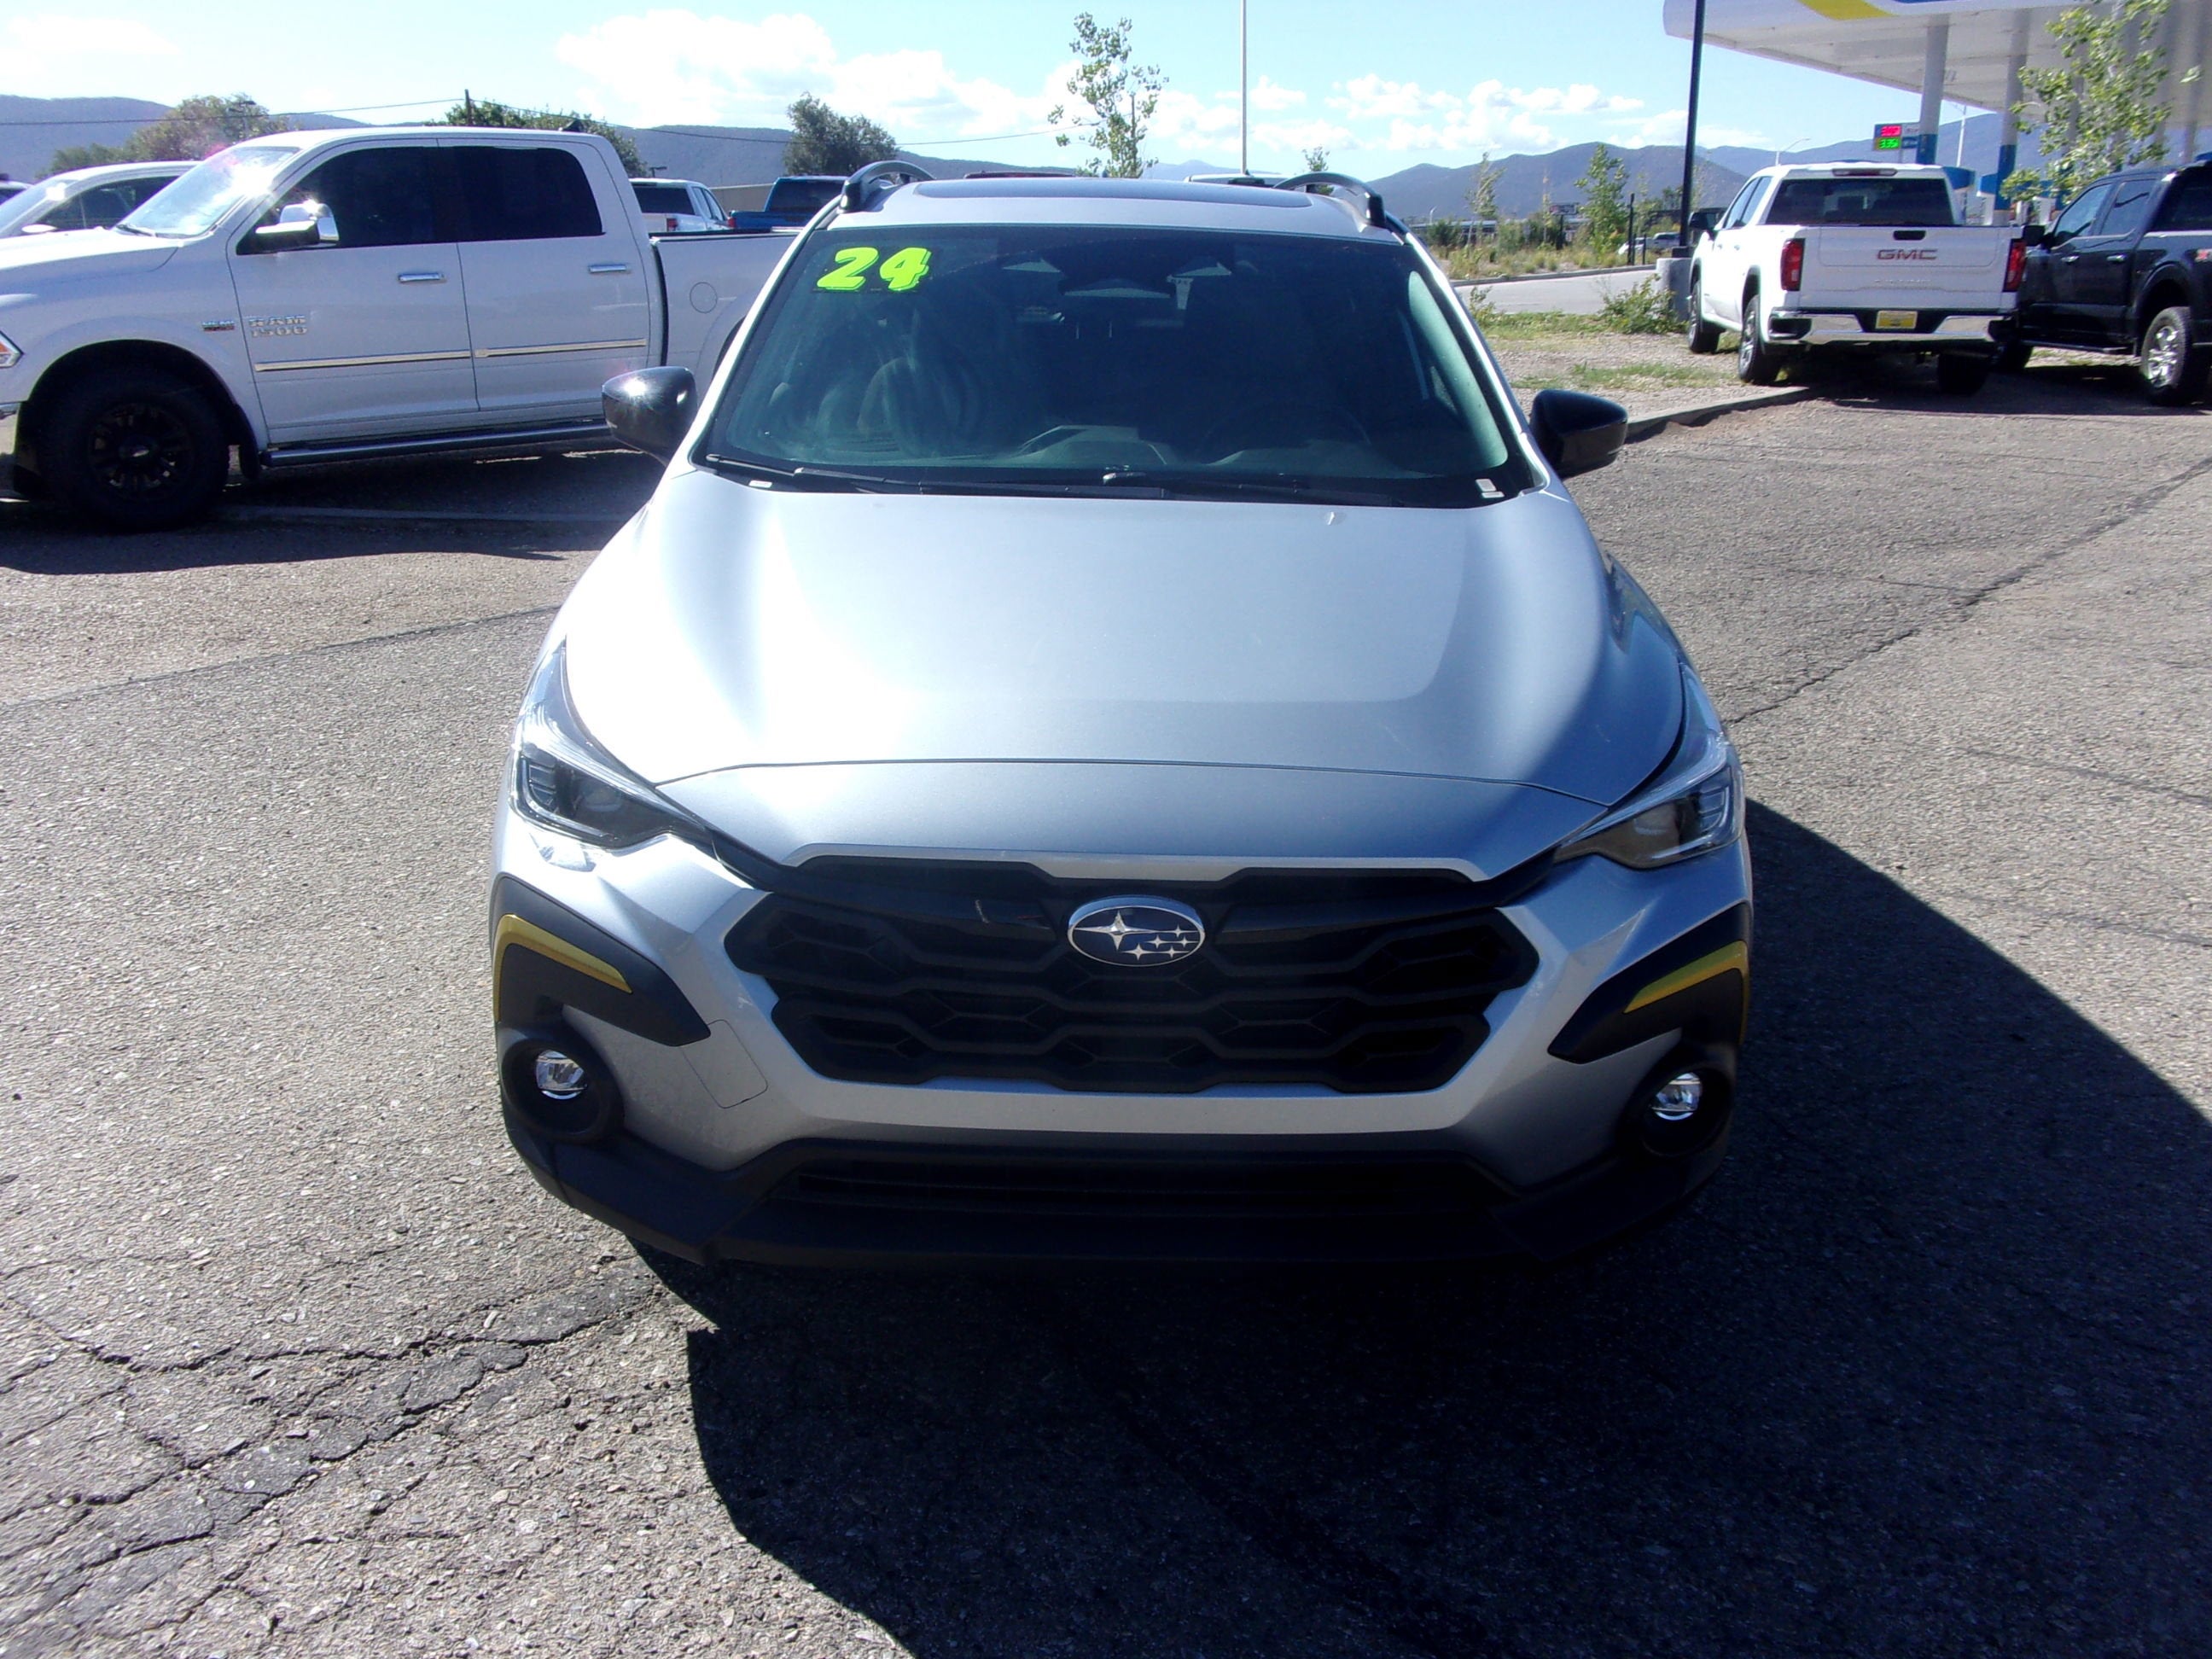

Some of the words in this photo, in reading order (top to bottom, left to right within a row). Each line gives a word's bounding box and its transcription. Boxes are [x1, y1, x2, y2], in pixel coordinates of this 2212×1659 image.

[1877, 248, 1938, 260] GMC
[817, 247, 932, 291] 24
[248, 315, 306, 327] RAM
[251, 325, 307, 337] 1500
